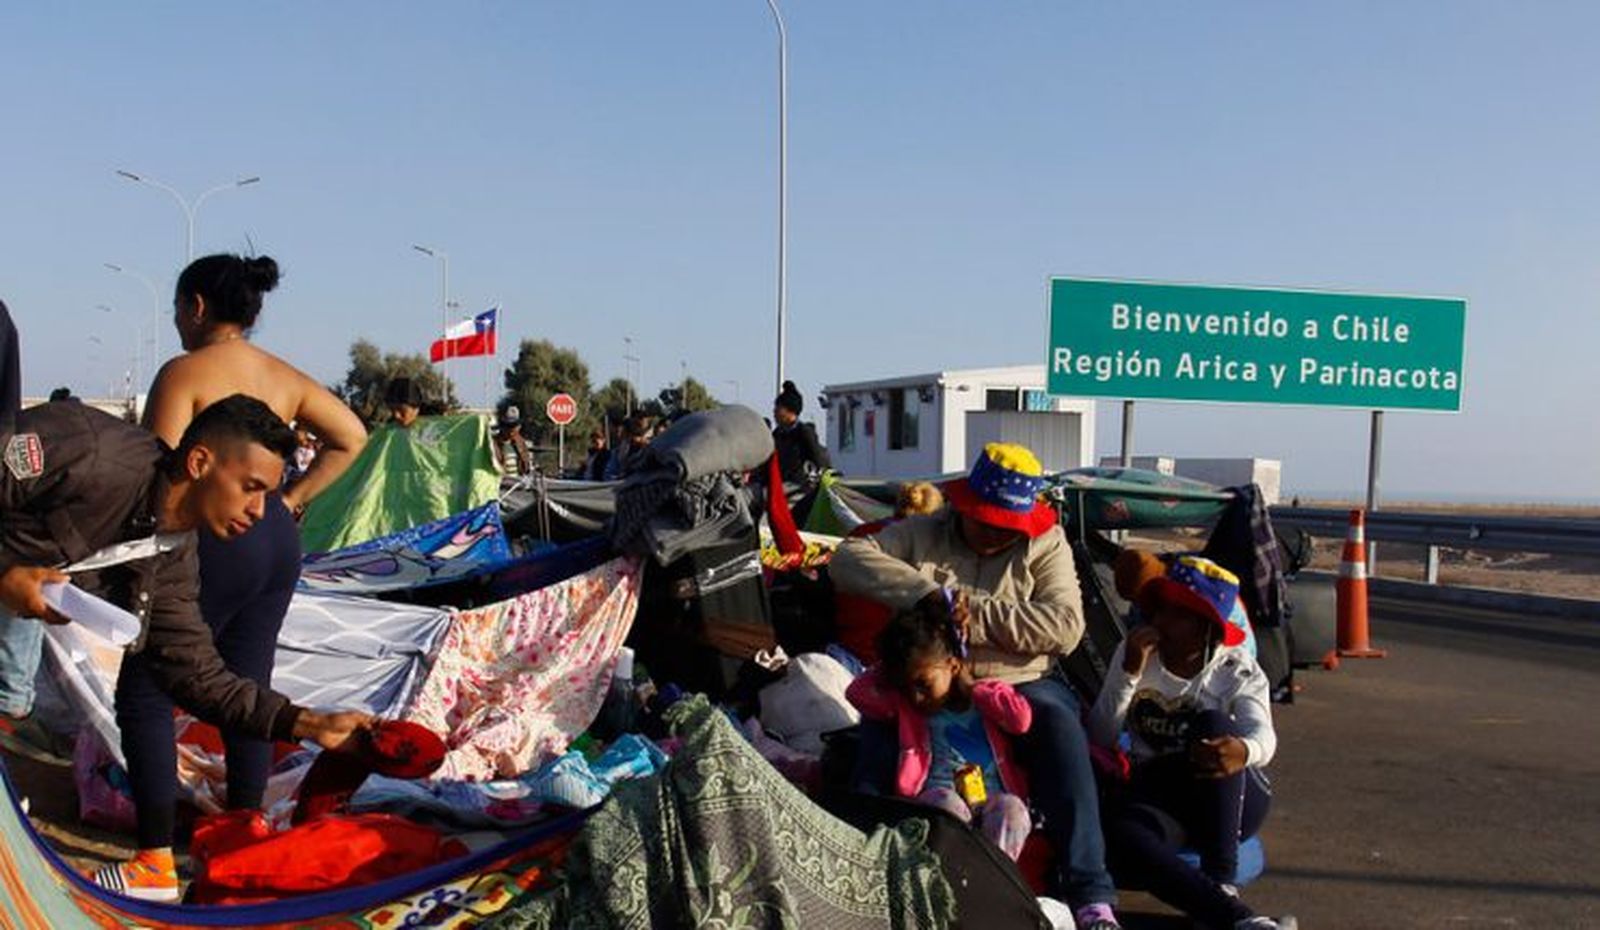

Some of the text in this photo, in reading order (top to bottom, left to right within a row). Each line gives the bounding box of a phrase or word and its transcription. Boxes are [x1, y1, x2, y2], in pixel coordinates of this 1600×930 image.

[1112, 303, 1410, 343] Bienvenido a Chile
[1053, 347, 1458, 390] Región Arica y Parinacota
